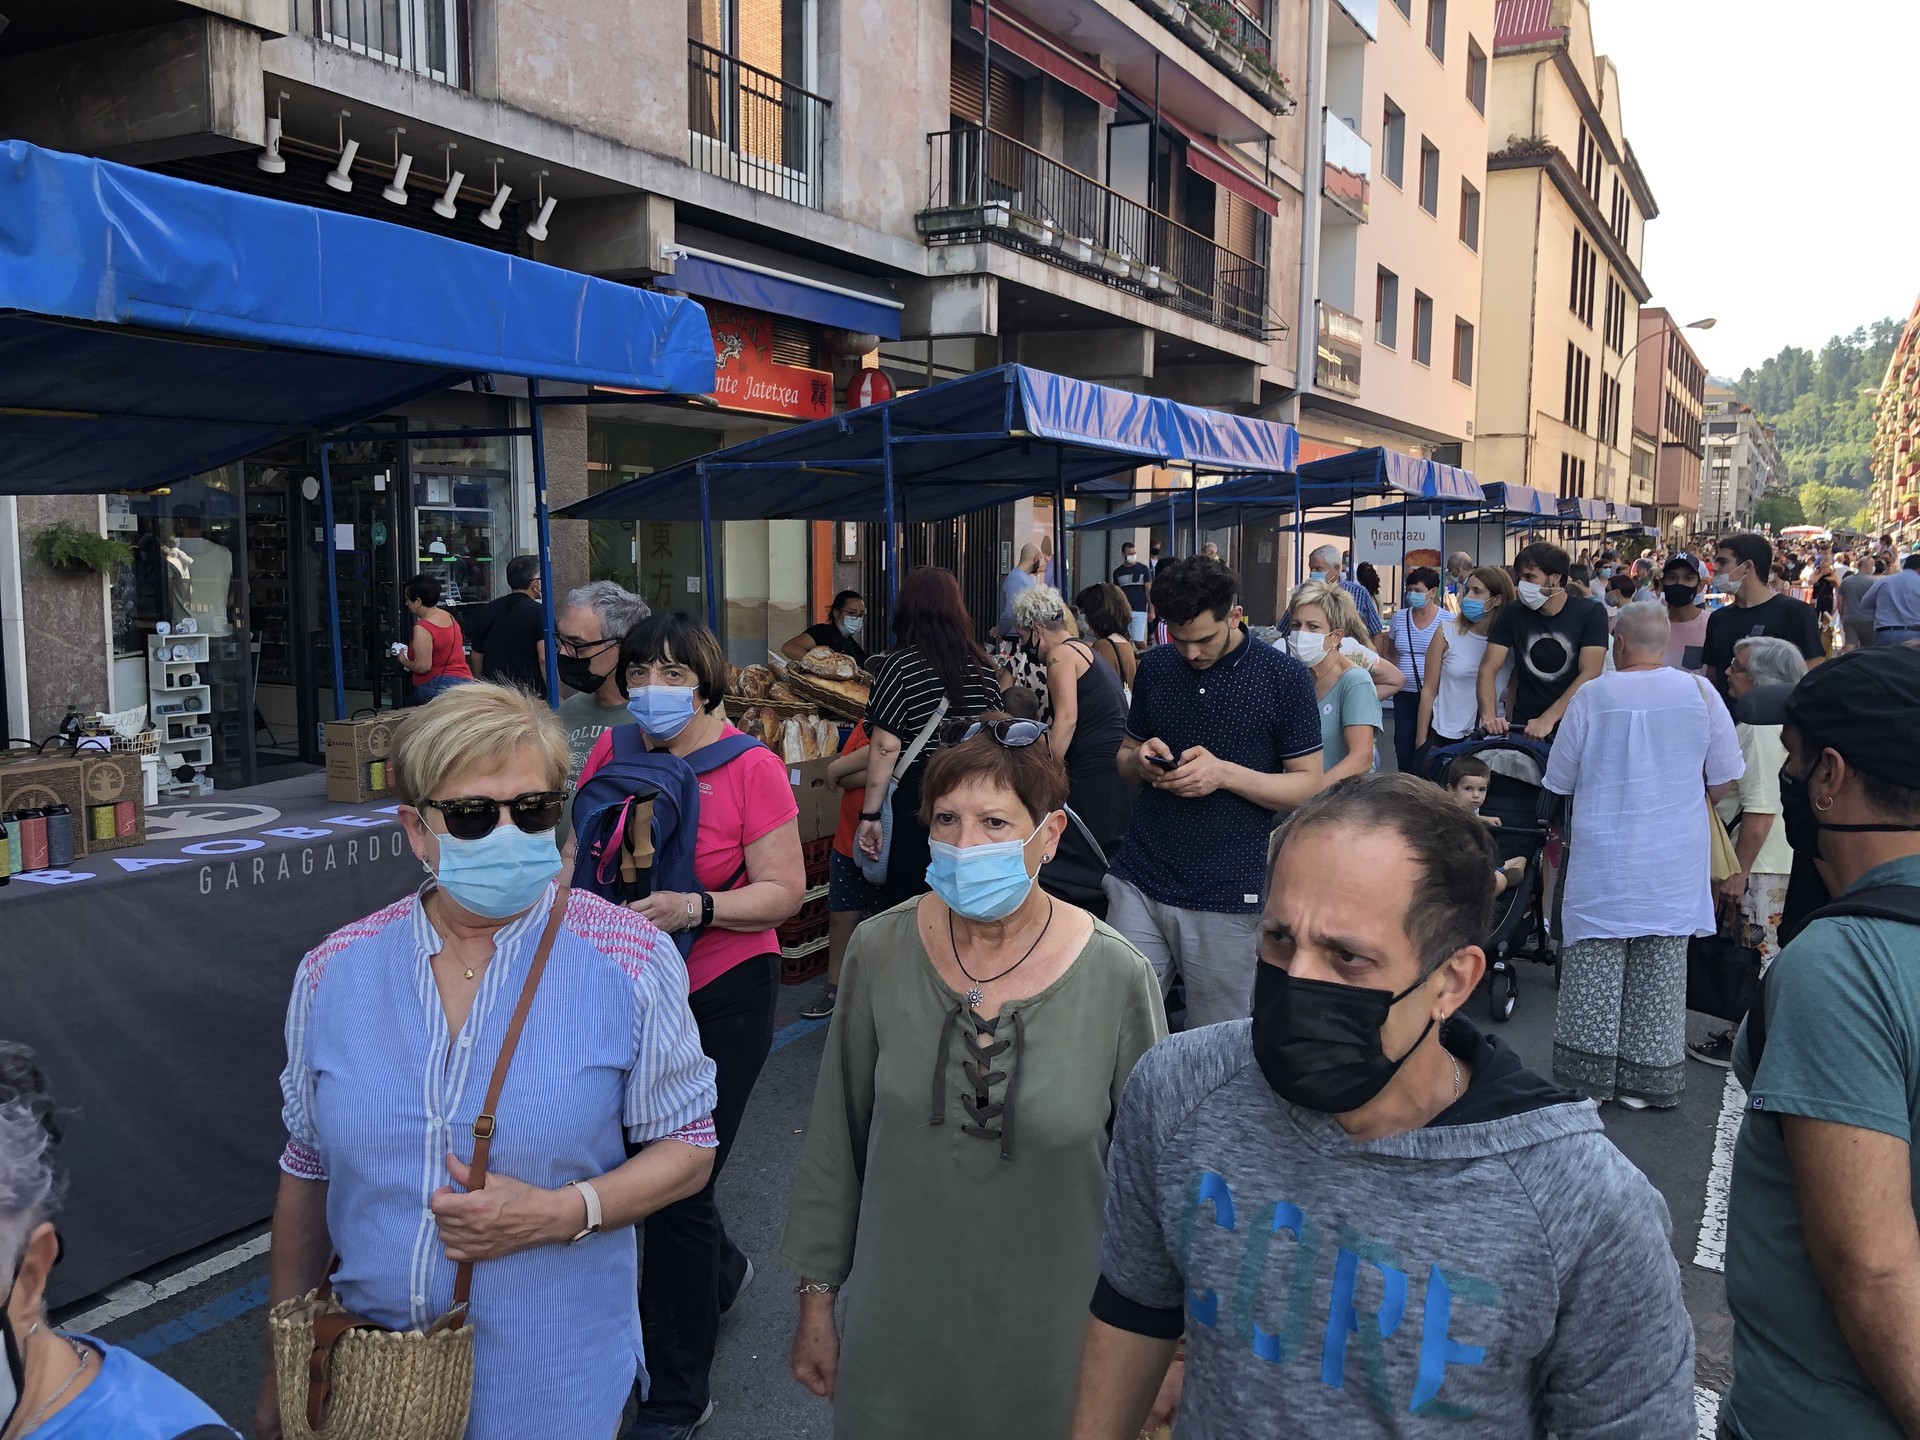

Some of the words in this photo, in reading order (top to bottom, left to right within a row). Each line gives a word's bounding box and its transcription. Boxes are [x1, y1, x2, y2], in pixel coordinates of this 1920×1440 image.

[743, 376, 799, 408] Jatetxea
[1371, 529, 1426, 541] Arantazu
[1180, 1172, 1499, 1417] CORE
